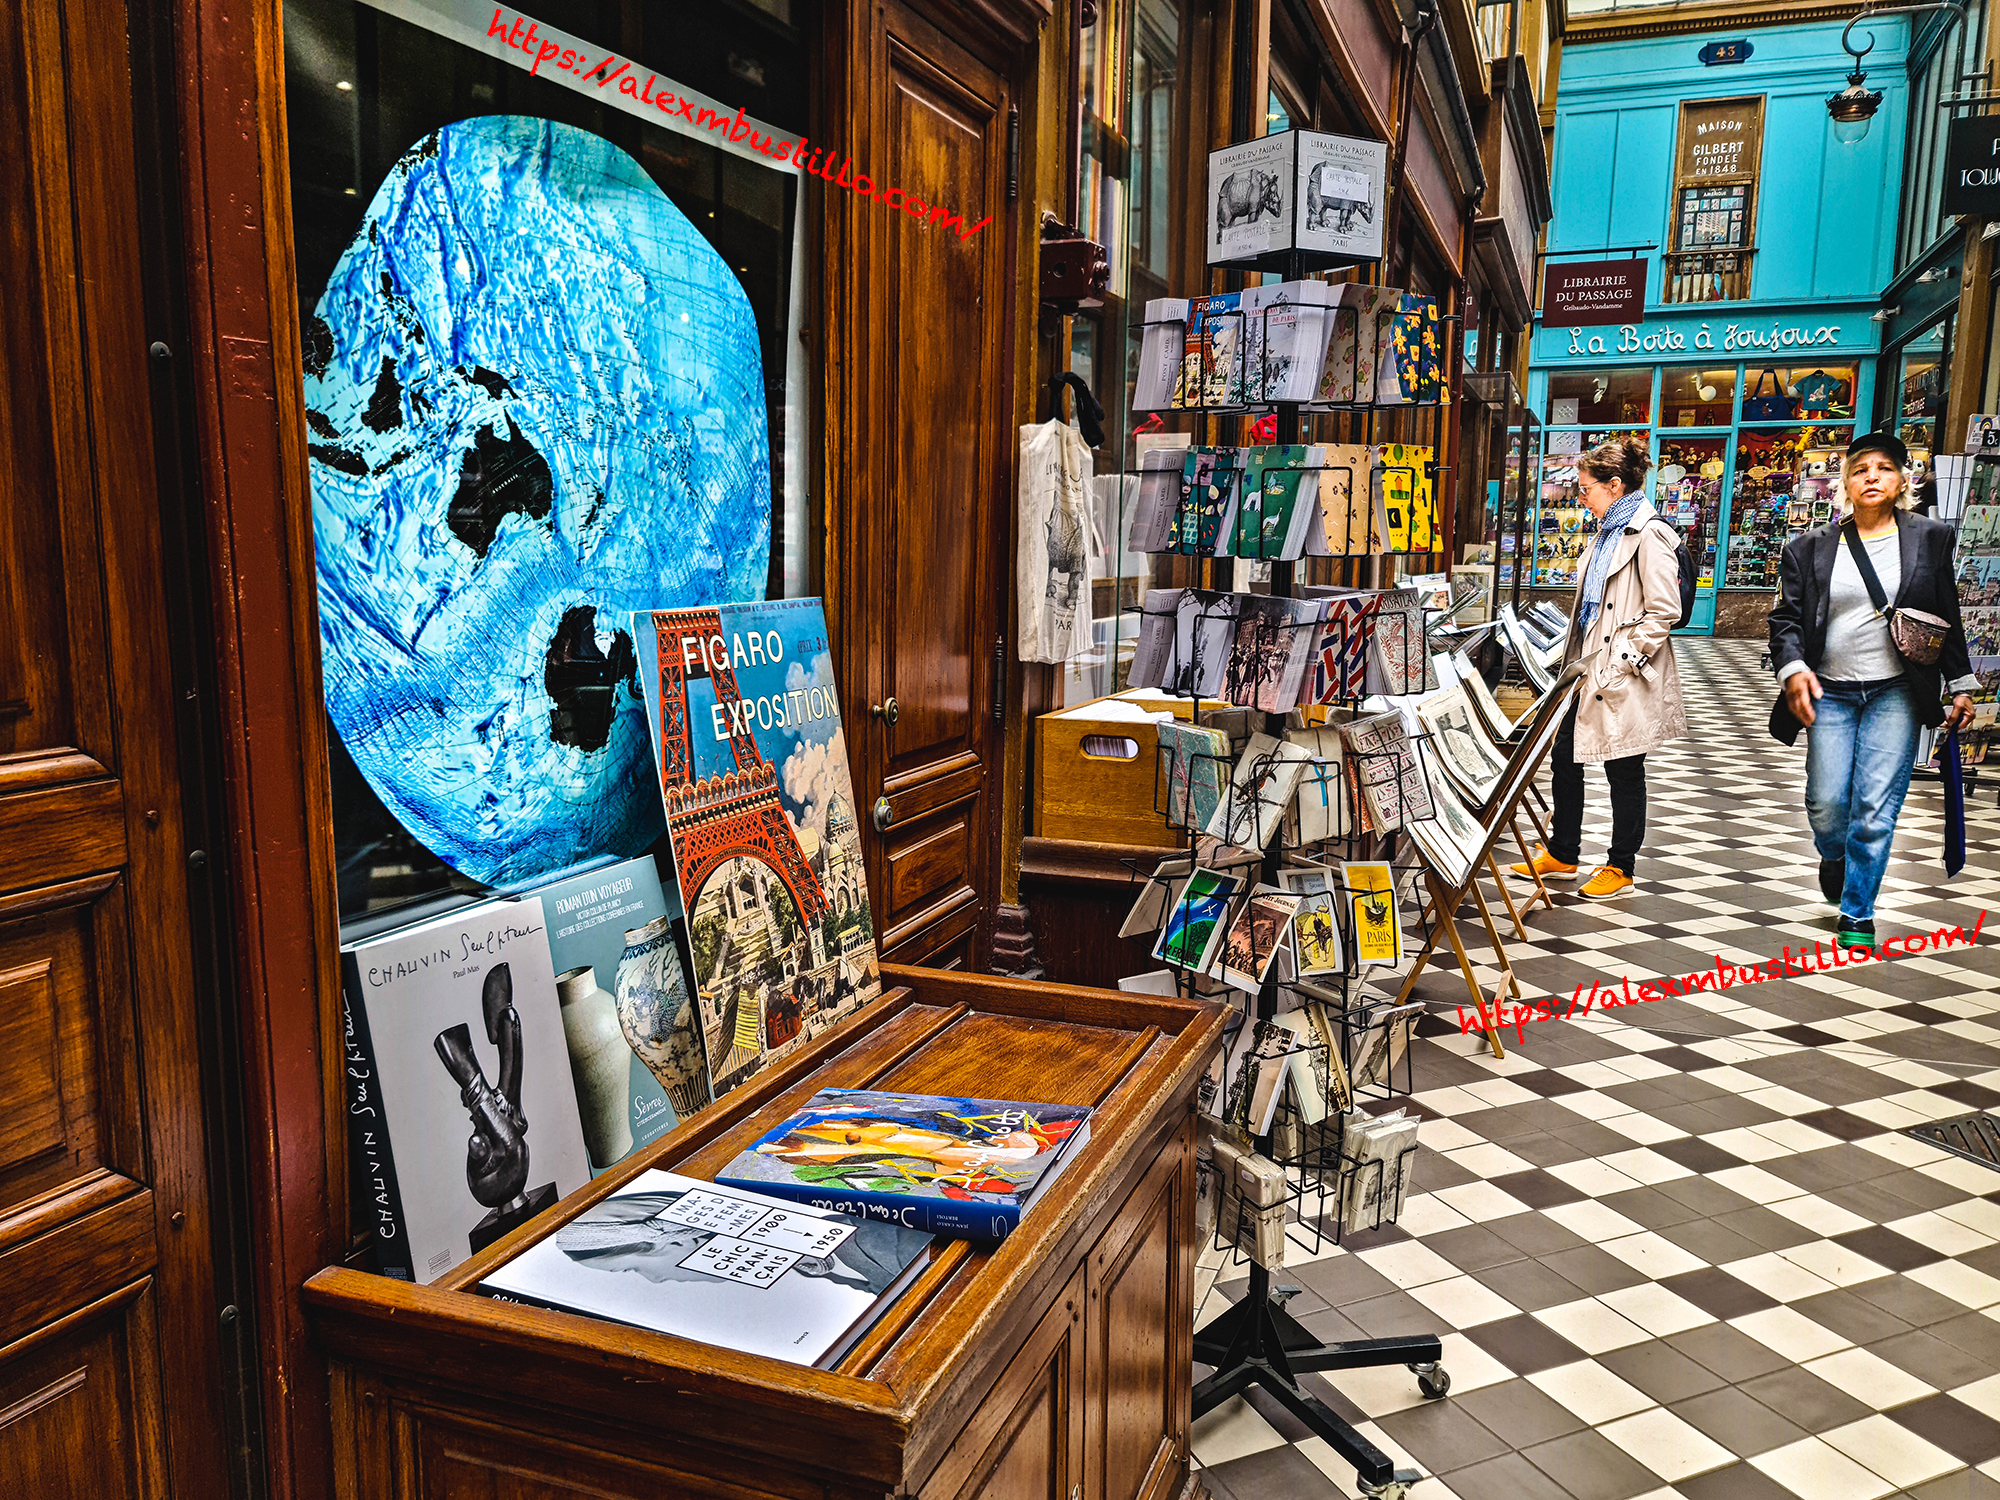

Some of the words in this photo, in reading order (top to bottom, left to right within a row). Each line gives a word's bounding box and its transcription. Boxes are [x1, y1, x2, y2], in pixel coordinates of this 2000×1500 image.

[1716, 45, 1736, 58] 43
[1697, 120, 1743, 135] MAISON
[1219, 152, 1246, 165] LIBRAIRIE
[1247, 149, 1258, 157] DU
[1259, 142, 1283, 154] PASSAGE
[1310, 139, 1339, 152] LIBRAIRIE
[1351, 146, 1376, 158] PASSAGE
[1693, 141, 1744, 156] GILBERT
[1710, 164, 1737, 174] 1848
[1332, 239, 1348, 248] PARIS
[1563, 274, 1627, 289] LIBRAIRIE
[1555, 290, 1576, 302] DU
[1578, 287, 1633, 301] PASSAGE
[1197, 300, 1226, 312] FIGARO
[1568, 326, 1608, 355] La
[1694, 322, 1715, 349] à
[1723, 321, 1842, 352] Joujoux
[680, 629, 784, 675] FIGARO
[710, 683, 839, 742] EXPOSITION
[556, 893, 583, 915] ROMAN
[597, 877, 634, 900] VOYAGEUR
[368, 948, 451, 988] CHAUVIN
[461, 925, 543, 962] Sculpteur
[452, 968, 467, 979] Paul
[467, 964, 480, 974] Mas
[634, 1095, 667, 1120] Sèvres
[364, 1131, 396, 1239] CHAUVIN
[686, 1204, 714, 1224] GES
[714, 1202, 744, 1221] FEM
[751, 1213, 788, 1238] 1900
[811, 1227, 844, 1251] 1950
[701, 1246, 723, 1259] LE
[713, 1244, 750, 1271] CHIC
[729, 1248, 769, 1279] FRAN-
[754, 1254, 789, 1281] ÇAIS
